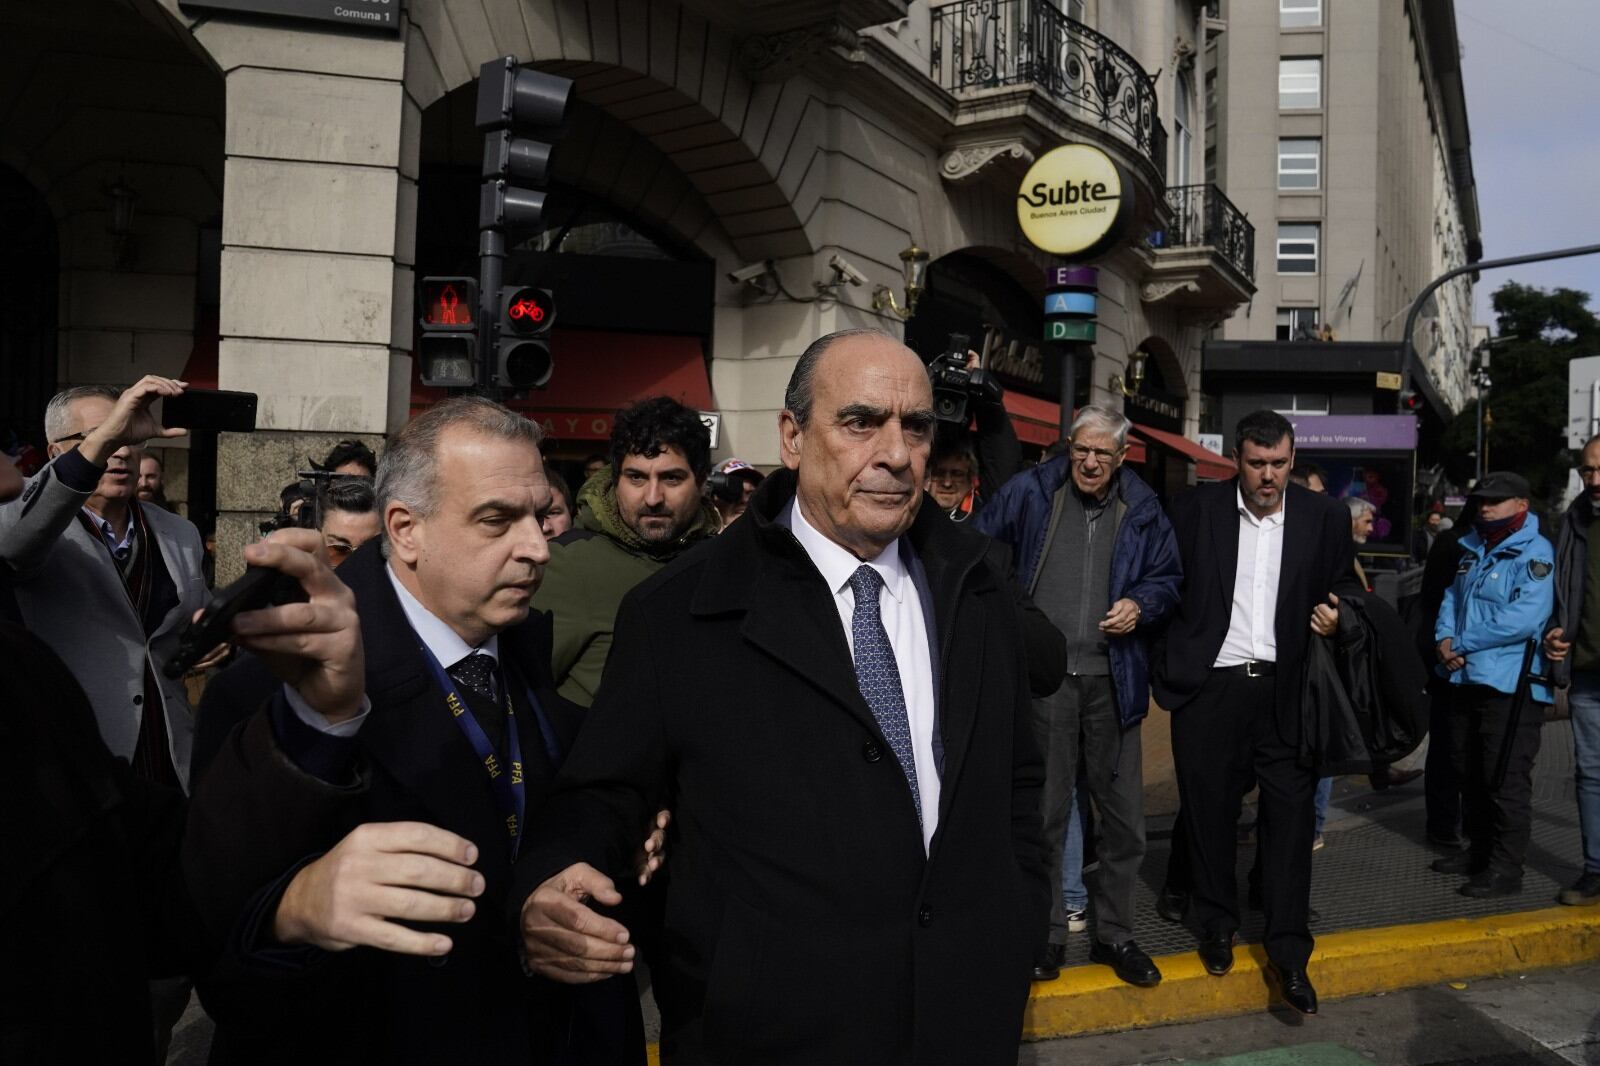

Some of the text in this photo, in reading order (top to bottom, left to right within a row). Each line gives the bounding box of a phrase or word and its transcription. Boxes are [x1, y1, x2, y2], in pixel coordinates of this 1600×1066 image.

[334, 6, 390, 21] Comuna 1
[1027, 180, 1108, 208] Subte
[1030, 206, 1106, 220] Buenos Aires Ciudad
[1056, 267, 1067, 285] E
[1054, 296, 1067, 311] A
[1053, 322, 1066, 338] D
[543, 418, 607, 434] AYO
[1295, 434, 1366, 445] aza de los Virreyes
[447, 692, 465, 717] PFA
[485, 754, 501, 779] PFA
[512, 761, 523, 784] PFA
